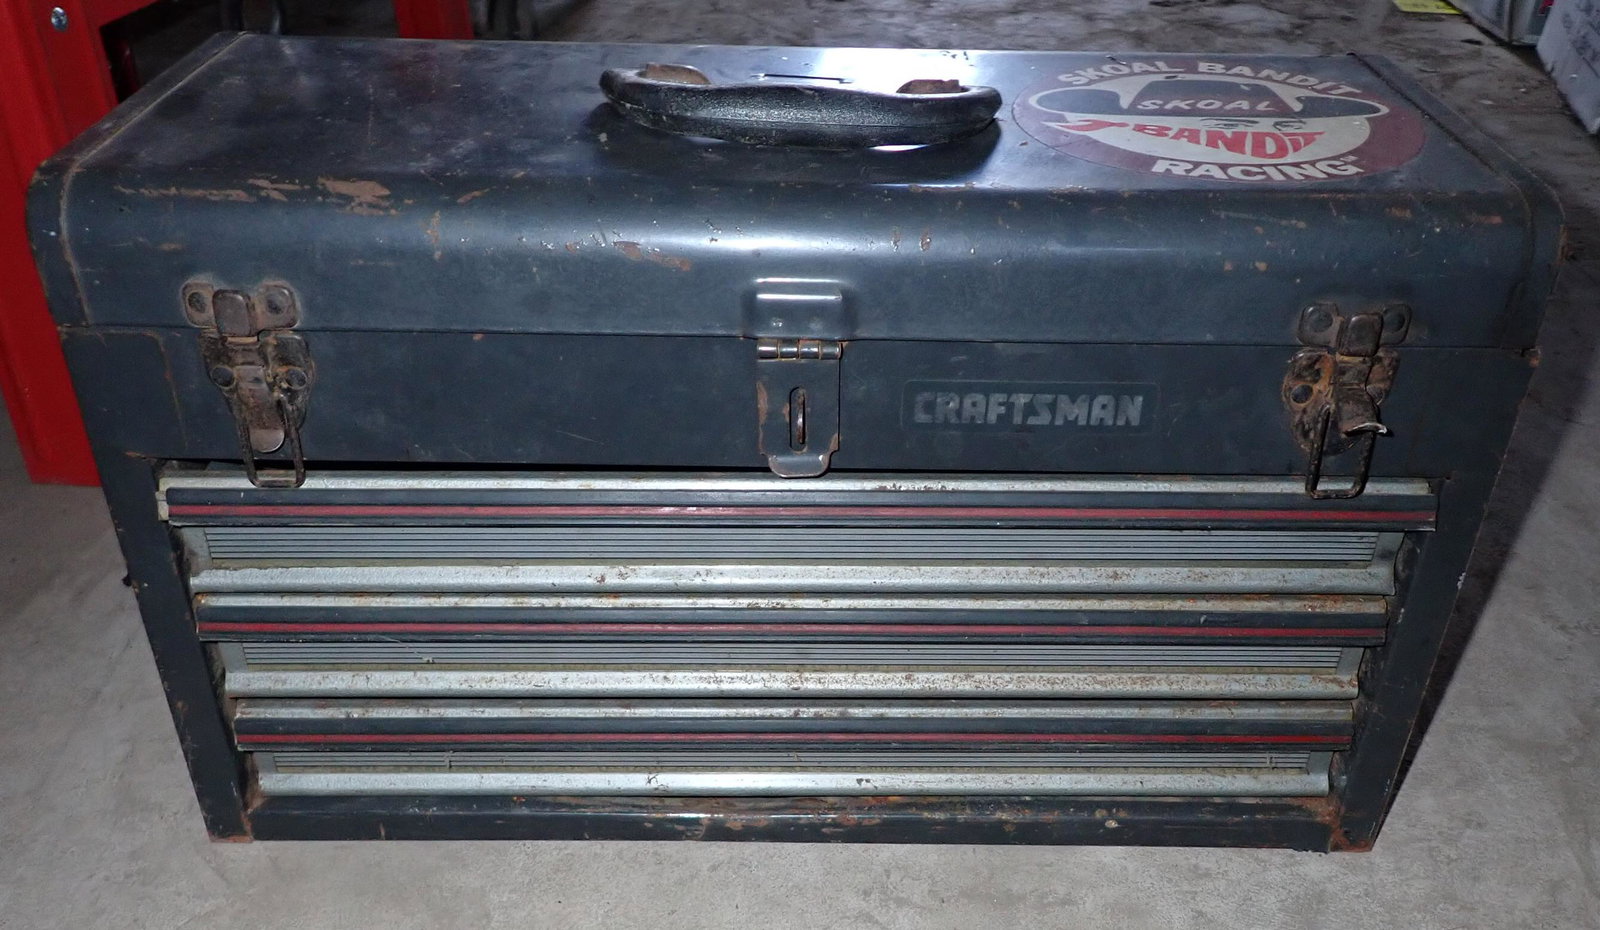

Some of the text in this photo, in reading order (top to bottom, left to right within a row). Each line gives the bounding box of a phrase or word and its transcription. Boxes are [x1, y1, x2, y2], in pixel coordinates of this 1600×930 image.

[1058, 61, 1362, 96] SKOAL BANDIT
[1137, 99, 1280, 112] SKOAL
[1132, 123, 1326, 160] BANDIT
[1151, 159, 1364, 181] RACING
[914, 391, 1144, 426] CRAFTSMAN
